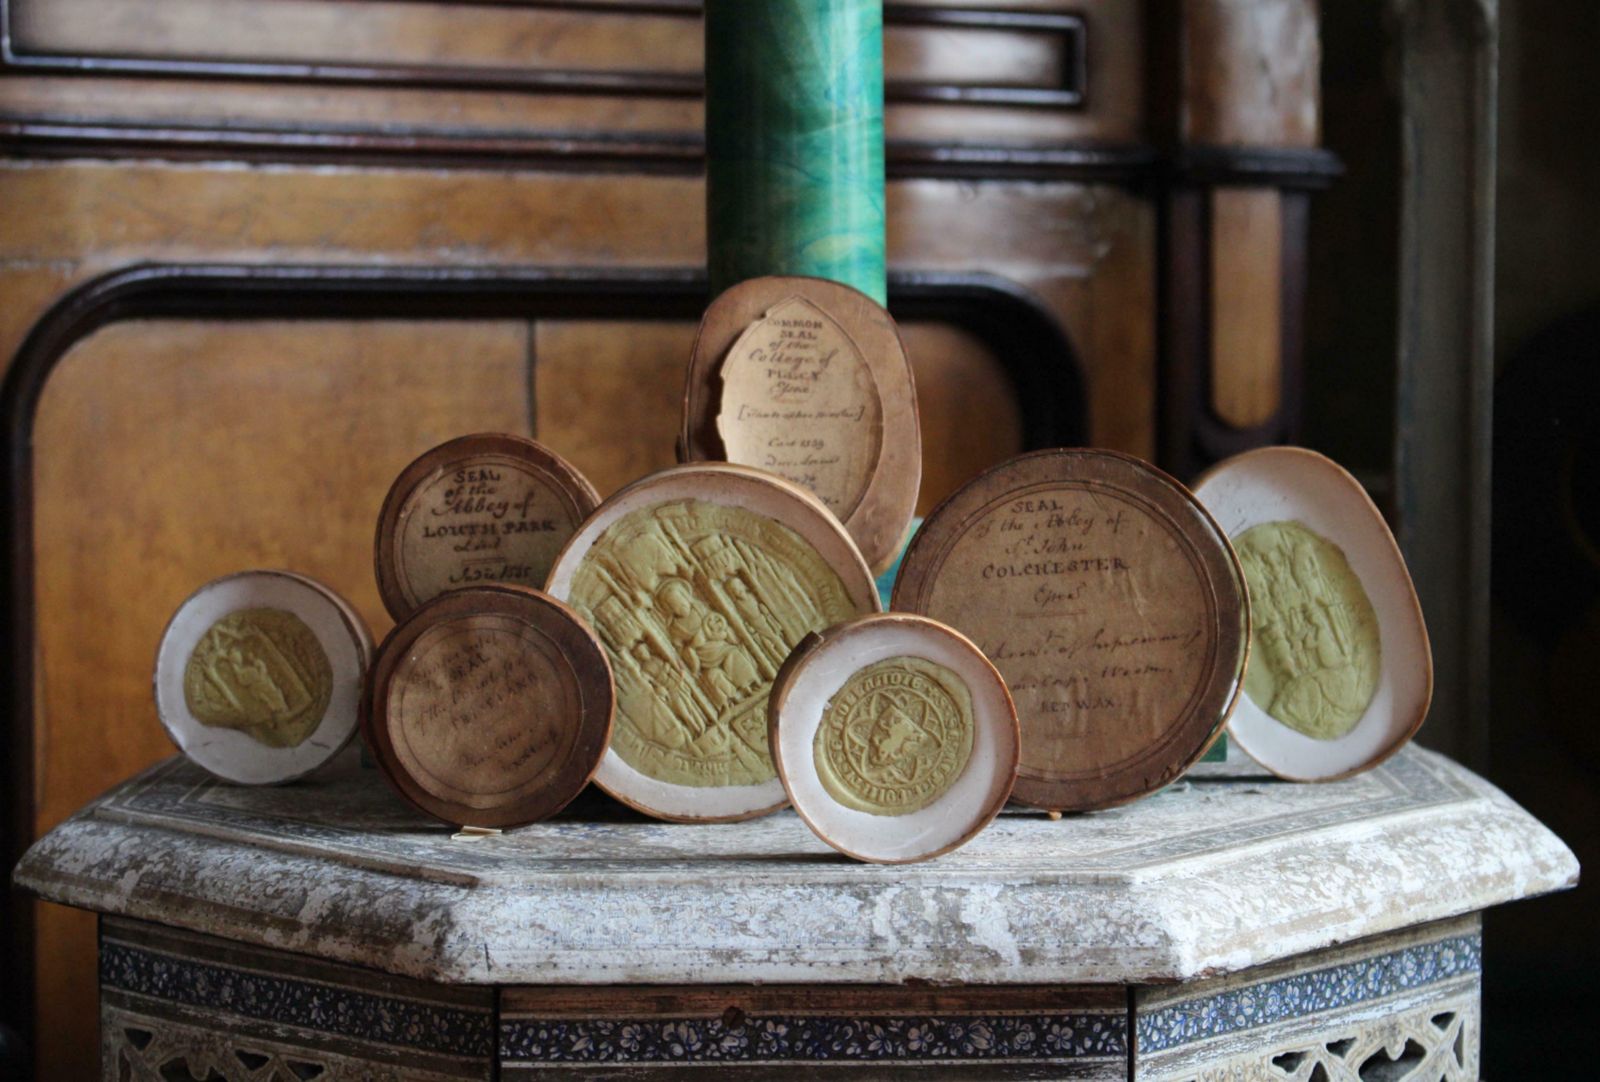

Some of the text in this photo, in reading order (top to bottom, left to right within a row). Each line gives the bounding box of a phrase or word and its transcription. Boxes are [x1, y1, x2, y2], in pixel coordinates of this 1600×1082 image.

[454, 470, 501, 483] SEAL
[432, 489, 534, 519] Abbey of
[1012, 500, 1064, 514] SEAL
[422, 520, 557, 538] LOUTH PARK
[1000, 518, 1024, 532] the
[982, 557, 1132, 580] COLCHESTER
